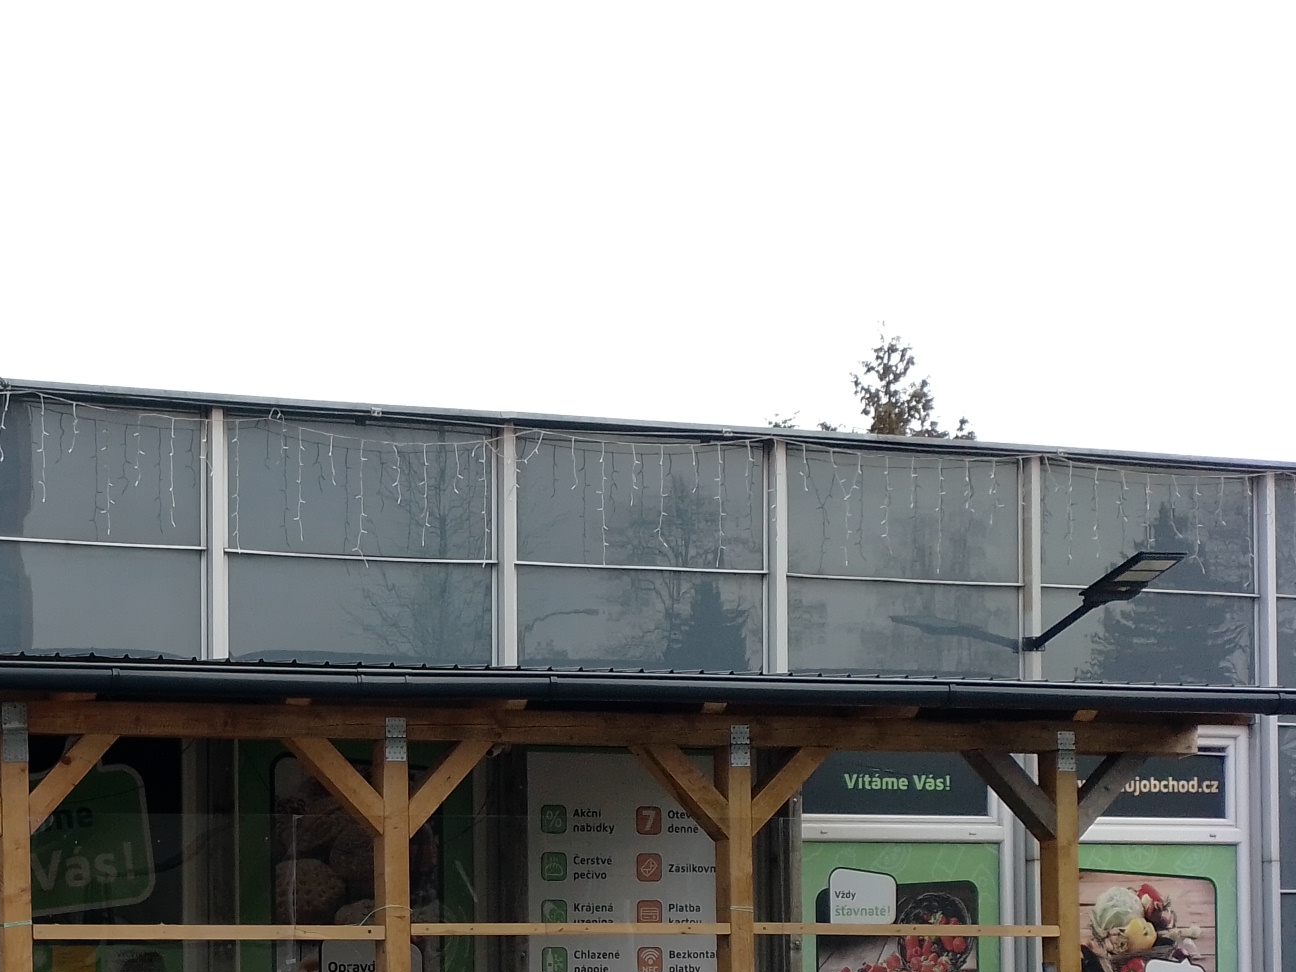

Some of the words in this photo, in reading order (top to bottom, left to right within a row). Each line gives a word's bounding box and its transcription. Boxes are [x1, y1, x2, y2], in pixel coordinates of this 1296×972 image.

[843, 773, 909, 790] Vítáme
[912, 774, 951, 791] Vás!
[573, 808, 602, 818] Akční
[573, 855, 613, 865] Čerstvé
[31, 841, 134, 891] Vás!
[668, 863, 716, 873] Zásilkovn
[573, 871, 607, 881] pečivo
[834, 890, 856, 901] Vždy
[573, 903, 613, 914] Krájená
[668, 903, 701, 913] Platba
[573, 949, 620, 960] Chlazené
